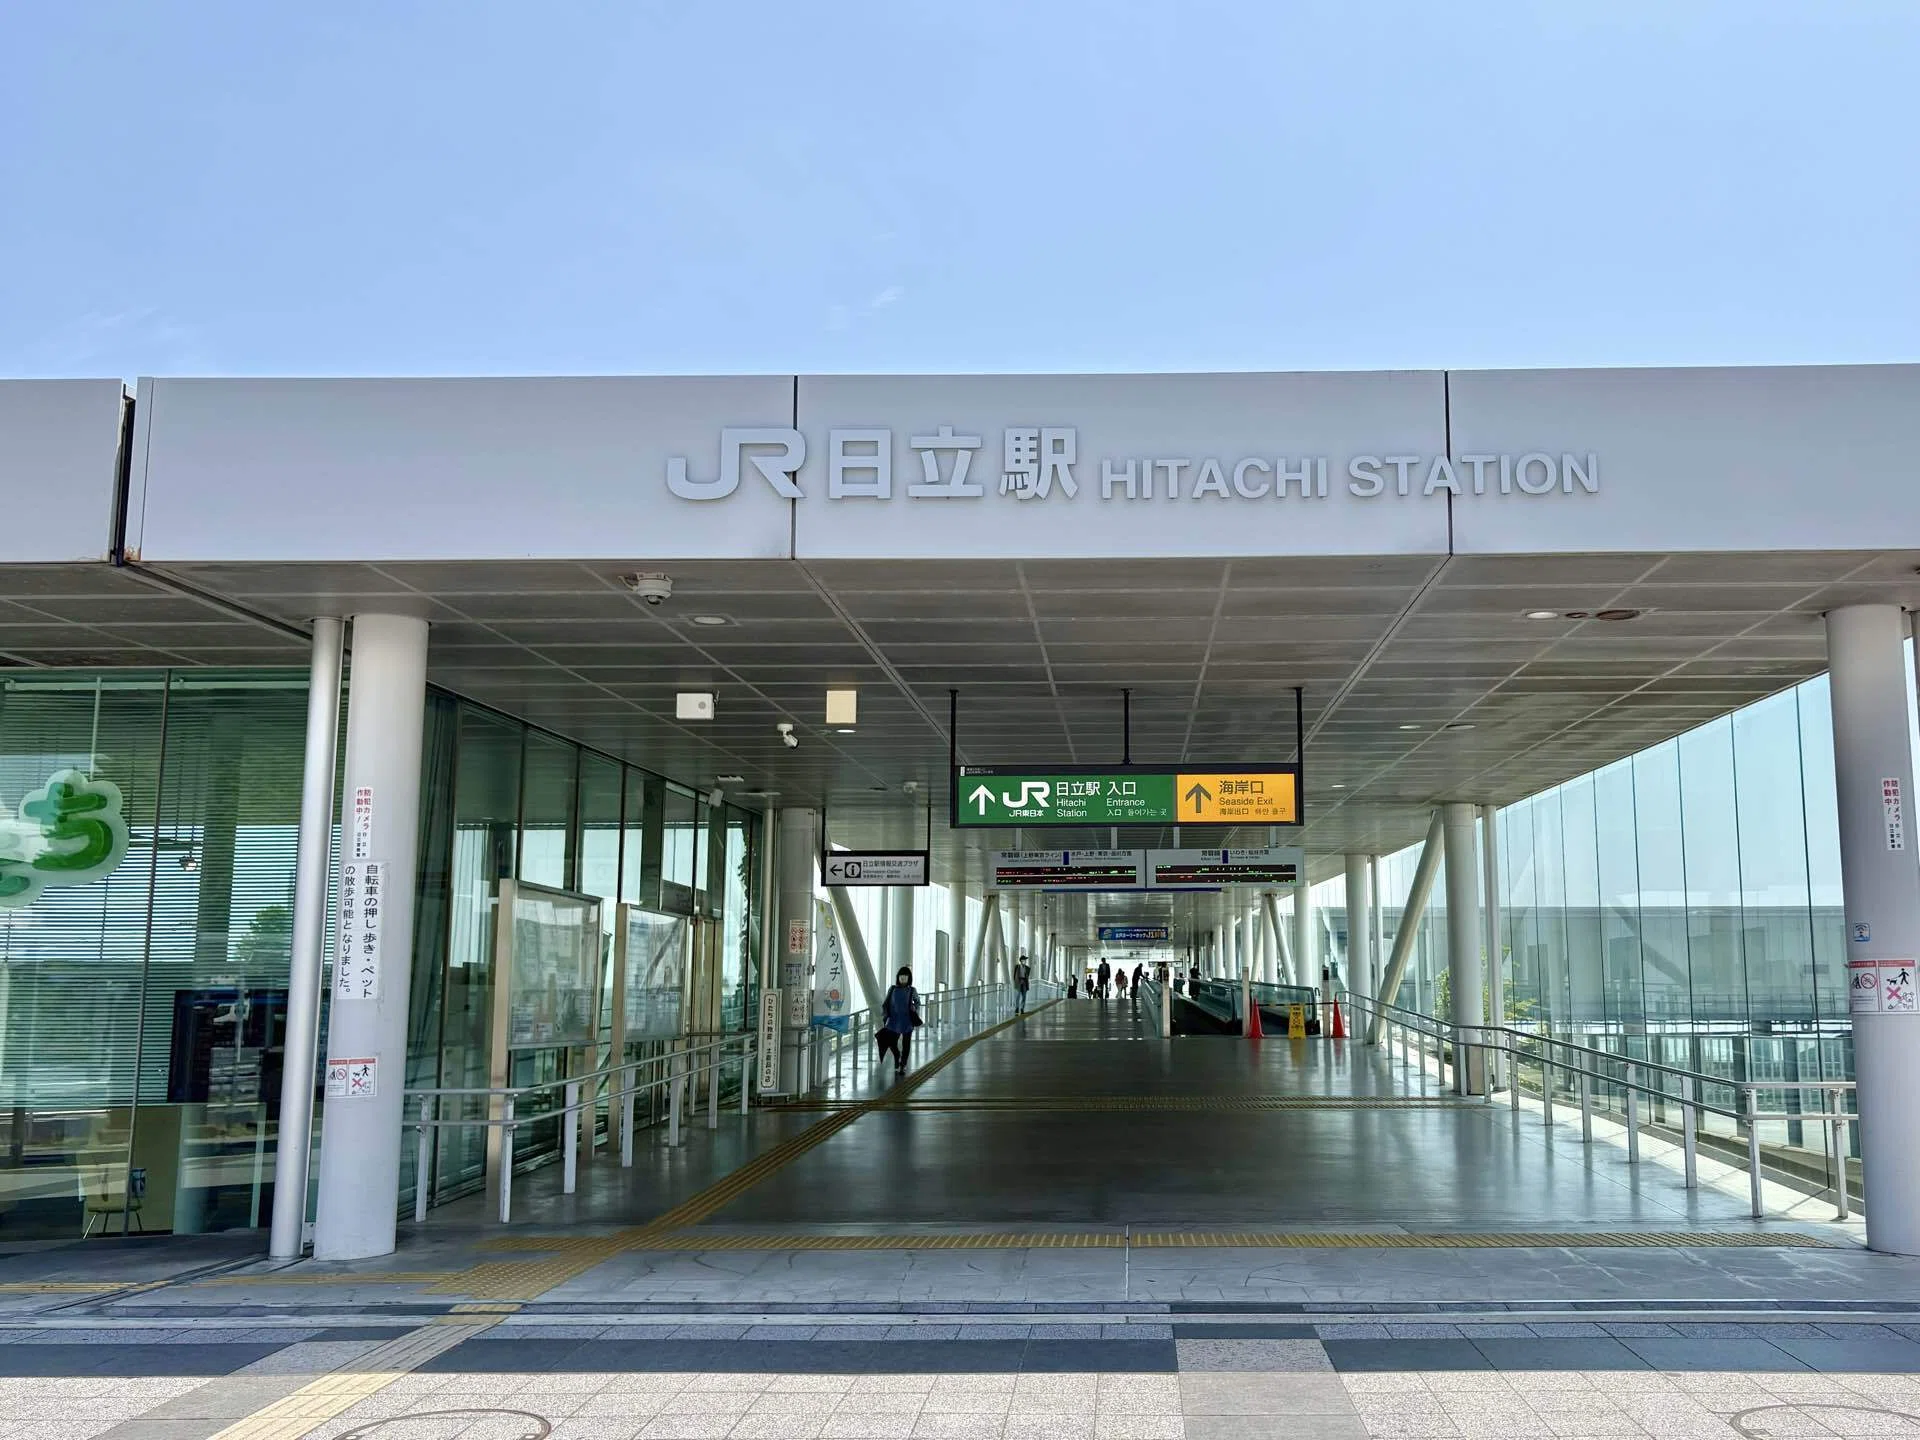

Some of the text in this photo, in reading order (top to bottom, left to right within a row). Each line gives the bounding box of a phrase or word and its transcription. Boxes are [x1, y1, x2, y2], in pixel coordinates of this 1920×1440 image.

[1101, 456, 1329, 500] HITACHI
[1348, 452, 1600, 499] STATION
[1055, 781, 1136, 796] 日立駅 入口
[1219, 780, 1264, 795] 海岸口
[1003, 781, 1050, 807] JR
[1056, 798, 1086, 808] Hitachi
[1107, 798, 1146, 807] Entrance
[1219, 797, 1274, 806] Seaside Exit
[1009, 809, 1044, 817] JR東日本
[1056, 808, 1087, 817] Station
[1106, 809, 1122, 817] 入口
[339, 865, 356, 994] の散歩可能となりました。
